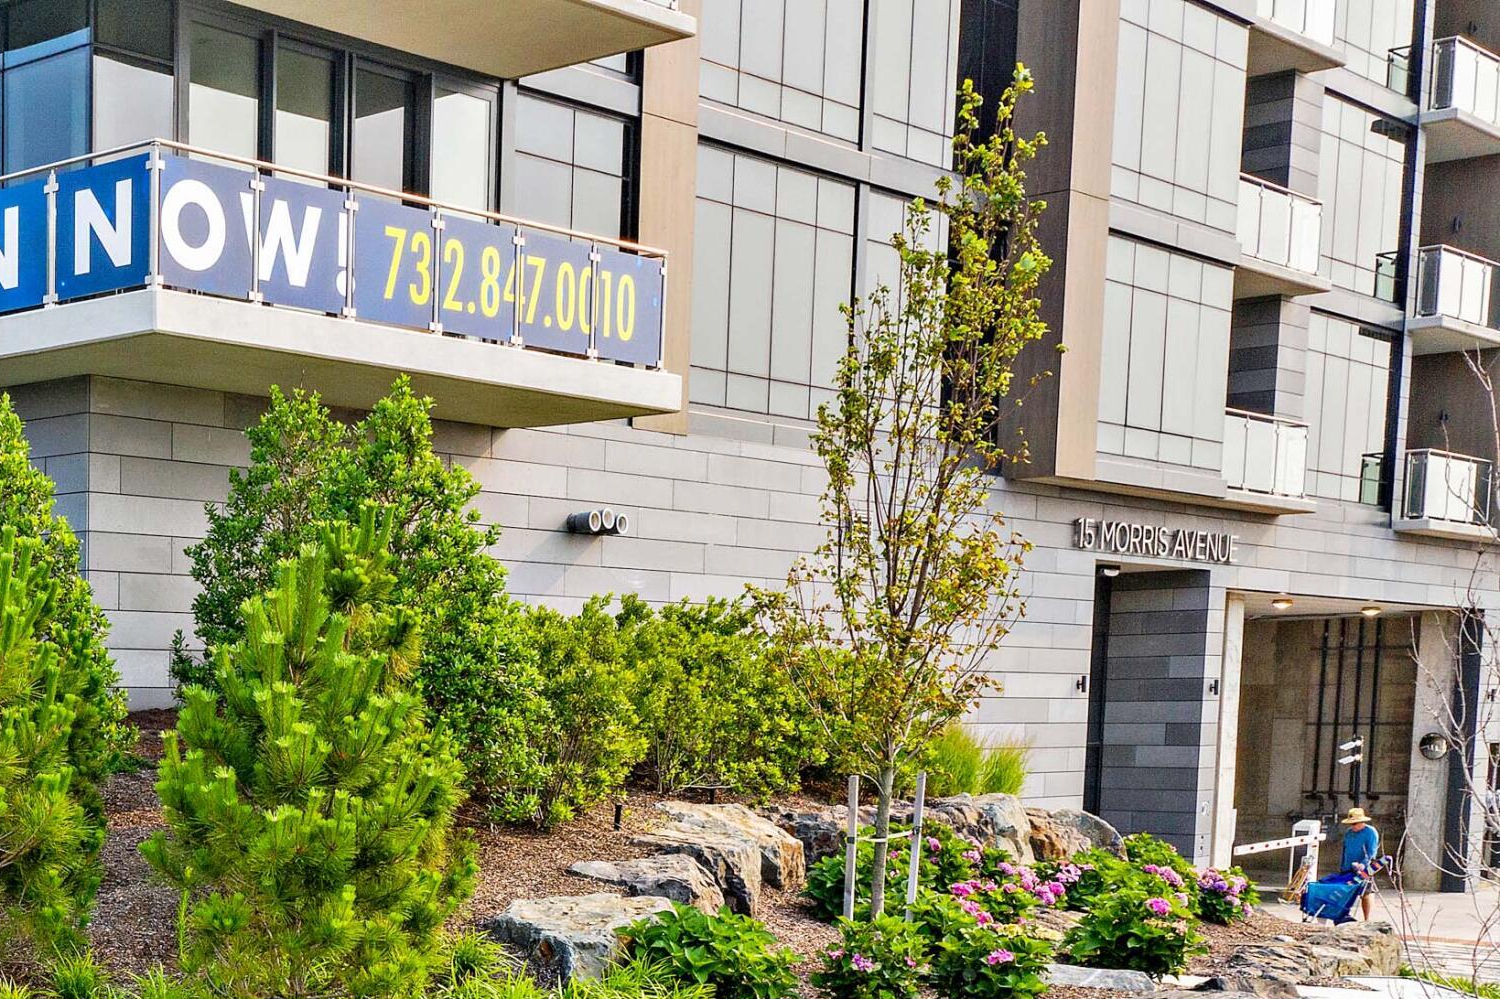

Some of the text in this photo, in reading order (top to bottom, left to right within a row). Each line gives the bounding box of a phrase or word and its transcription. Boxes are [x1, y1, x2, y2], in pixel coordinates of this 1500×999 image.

[74, 178, 356, 297] NOW!
[384, 225, 636, 342] 732.847.0010
[1076, 517, 1240, 563] 15 MORRIS AVENUE
